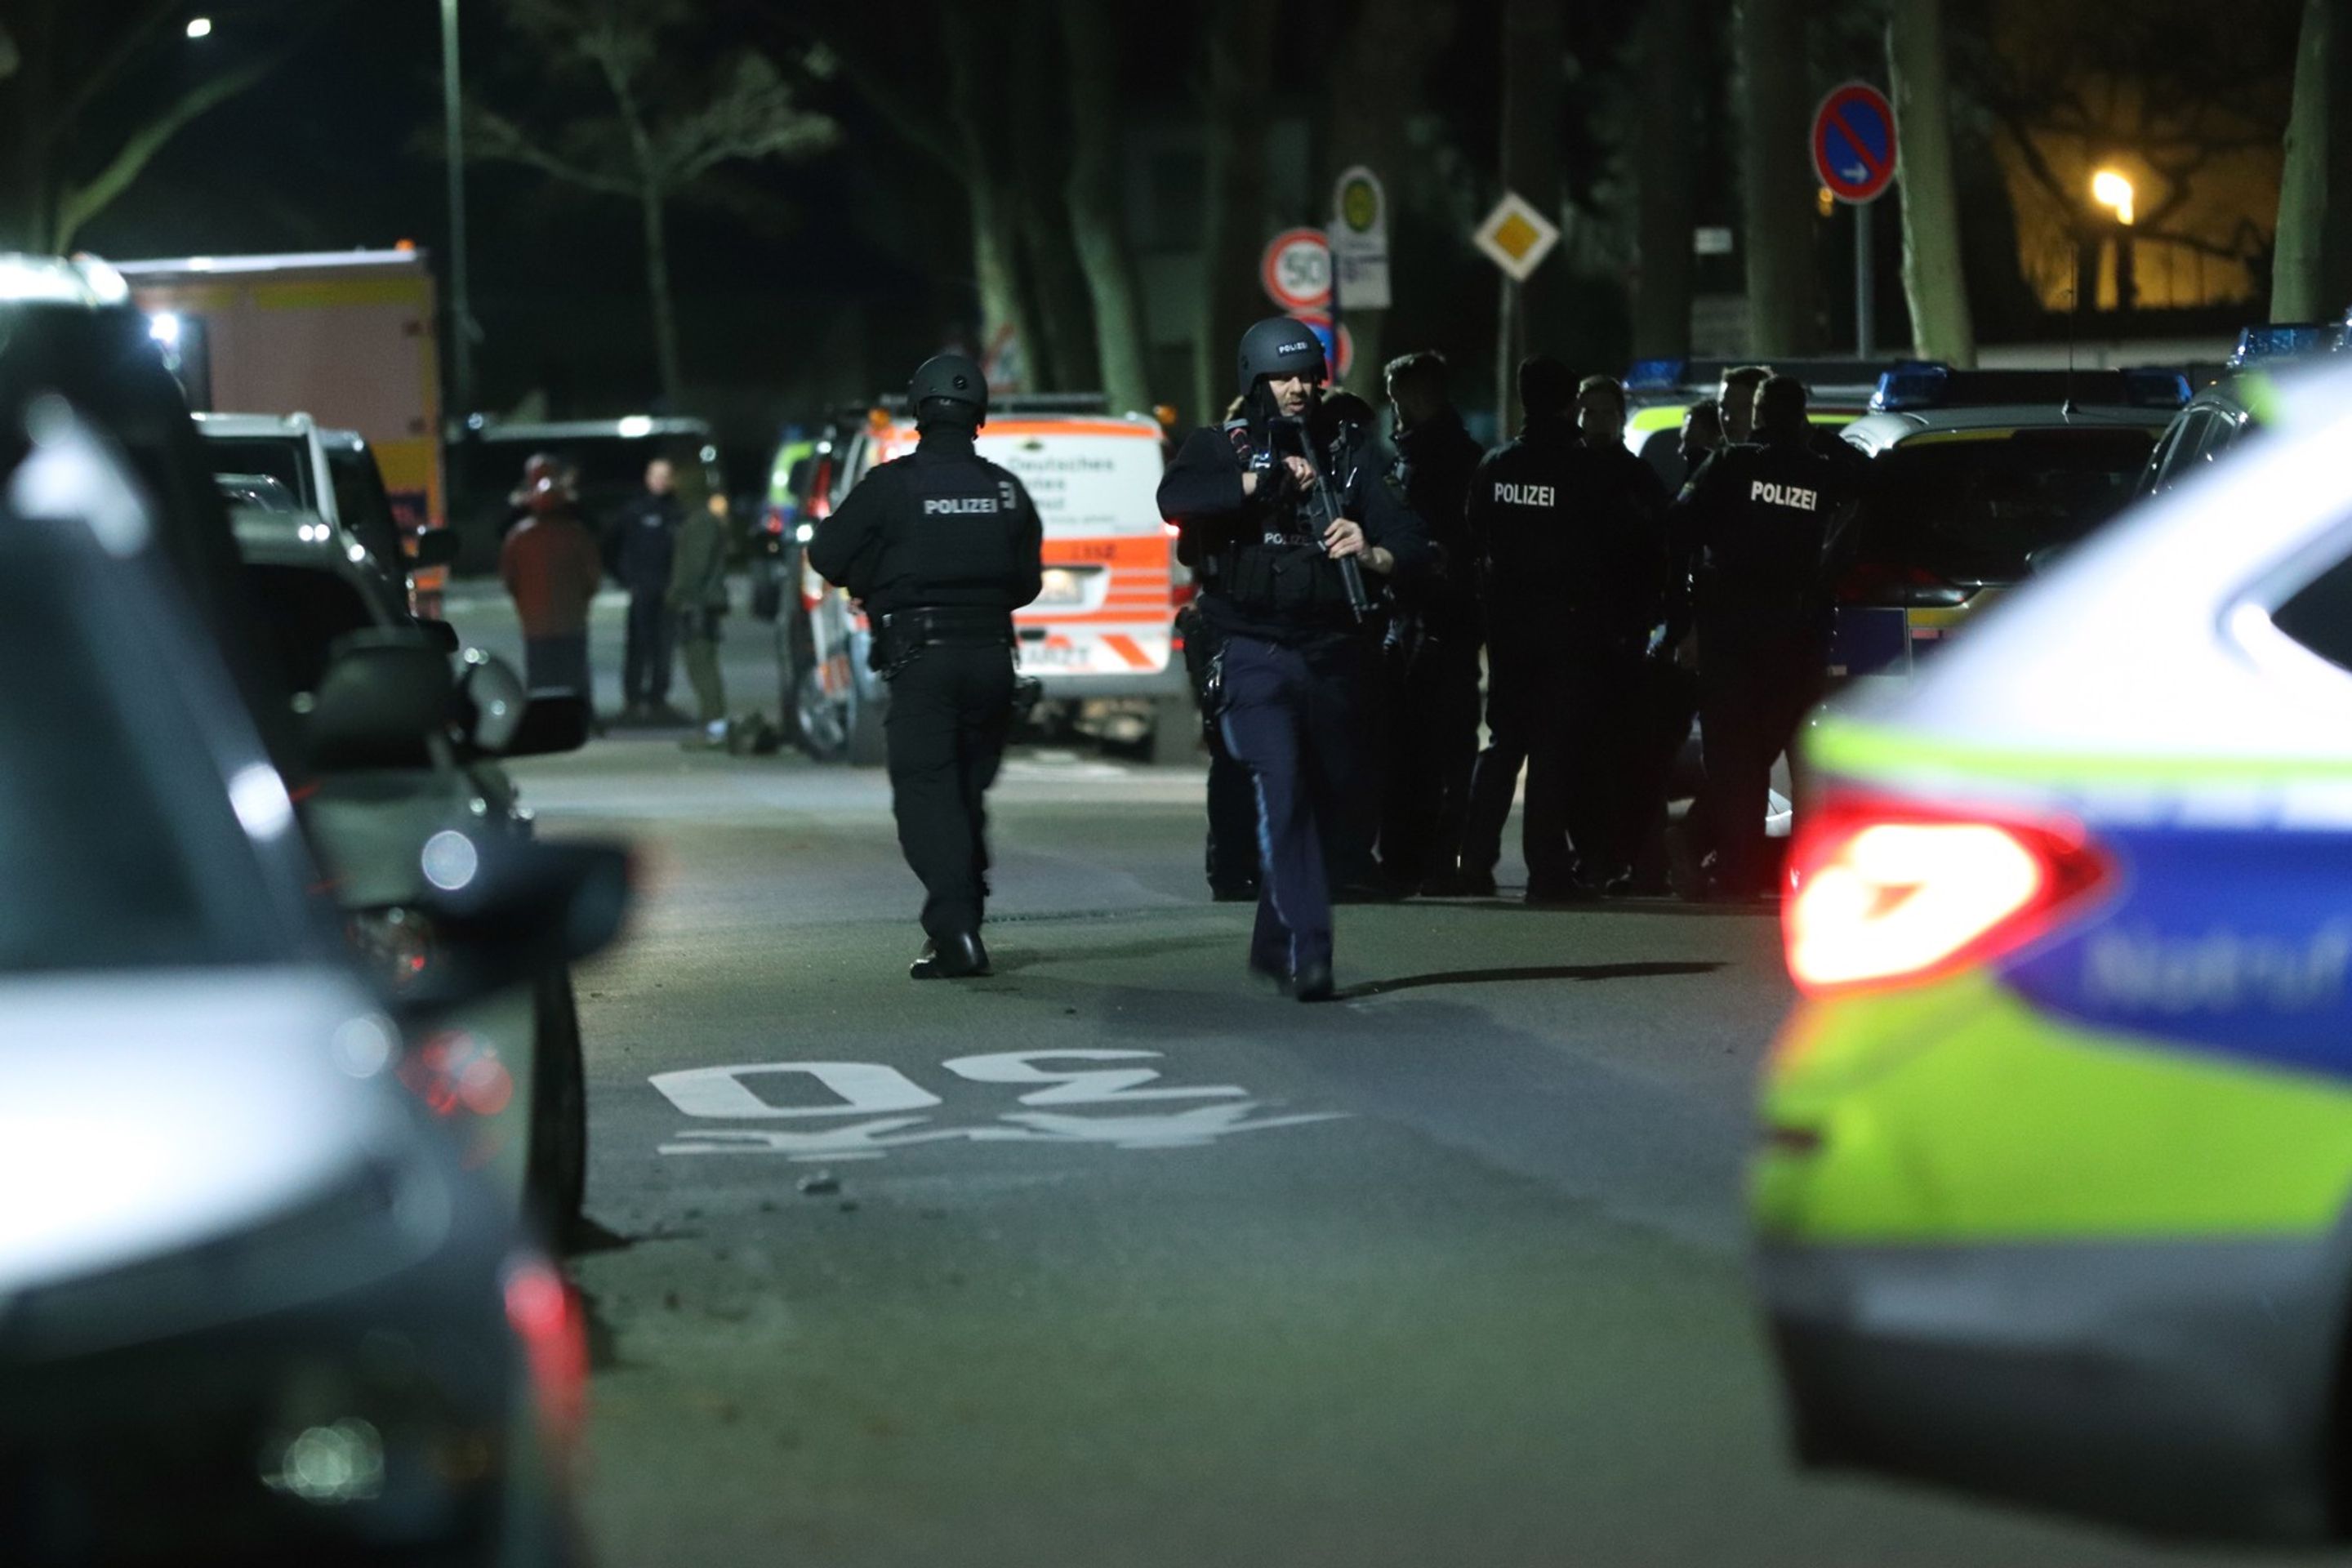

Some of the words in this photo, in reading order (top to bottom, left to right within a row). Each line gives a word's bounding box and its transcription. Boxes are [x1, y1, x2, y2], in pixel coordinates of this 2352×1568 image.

[1284, 251, 1329, 288] 50
[924, 498, 998, 514] POLIZEI
[1494, 482, 1555, 507] POLIZEI
[1750, 480, 1817, 511] POLIZEI
